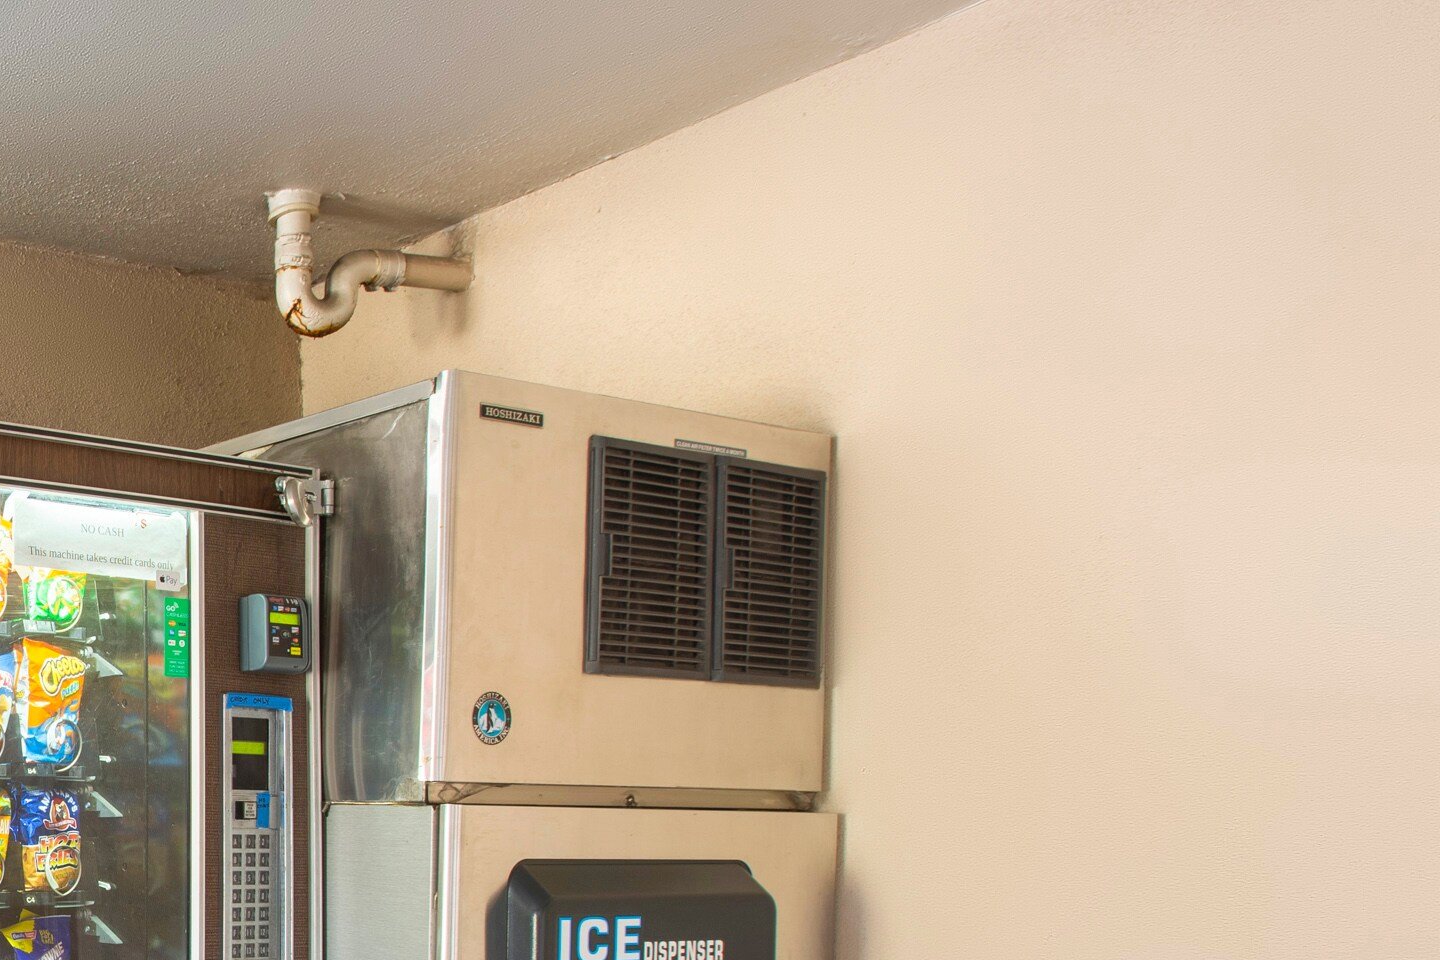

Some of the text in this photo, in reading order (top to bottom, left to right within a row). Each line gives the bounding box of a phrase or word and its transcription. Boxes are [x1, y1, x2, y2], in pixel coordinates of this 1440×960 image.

[485, 406, 541, 425] HOSHIZAKI
[676, 440, 691, 448] CLEAN
[698, 444, 713, 452] FILTER
[729, 448, 745, 456] MONTH
[80, 523, 126, 538] NO CASH
[28, 545, 47, 558] This
[49, 547, 85, 561] machine
[86, 552, 108, 564] takes
[109, 554, 133, 567] credit
[134, 556, 156, 569] cards
[157, 559, 174, 572] only
[165, 575, 178, 587] Pay
[165, 604, 176, 612] GO
[41, 656, 85, 694] Cheetos
[475, 692, 510, 710] HOSHIZAKI
[27, 767, 37, 775] B4
[26, 896, 36, 904] C4
